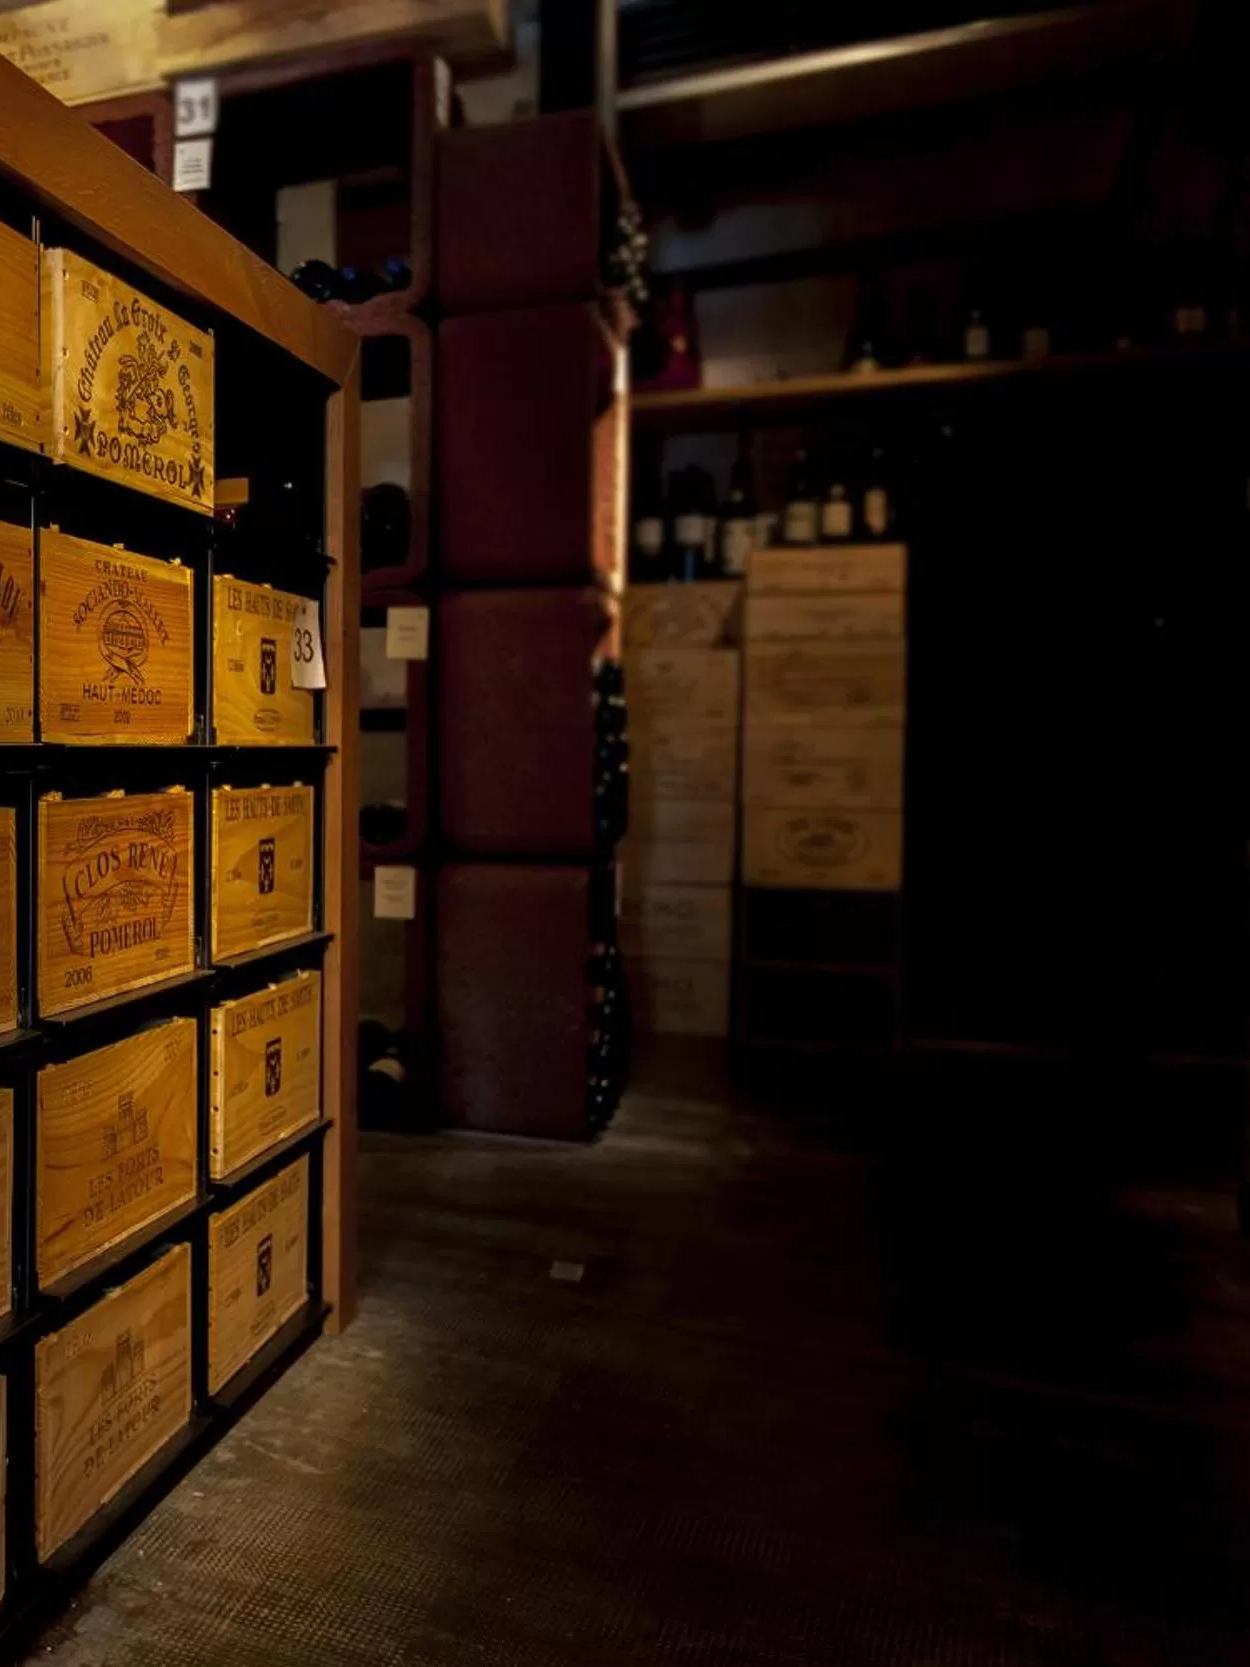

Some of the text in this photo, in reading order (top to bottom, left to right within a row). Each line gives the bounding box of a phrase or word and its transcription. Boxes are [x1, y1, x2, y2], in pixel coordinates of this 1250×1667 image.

[177, 95, 210, 124] 31
[95, 431, 192, 490] POMEROL
[294, 627, 315, 663] 33
[74, 847, 121, 900] CLOS
[90, 916, 160, 958] POMEROL
